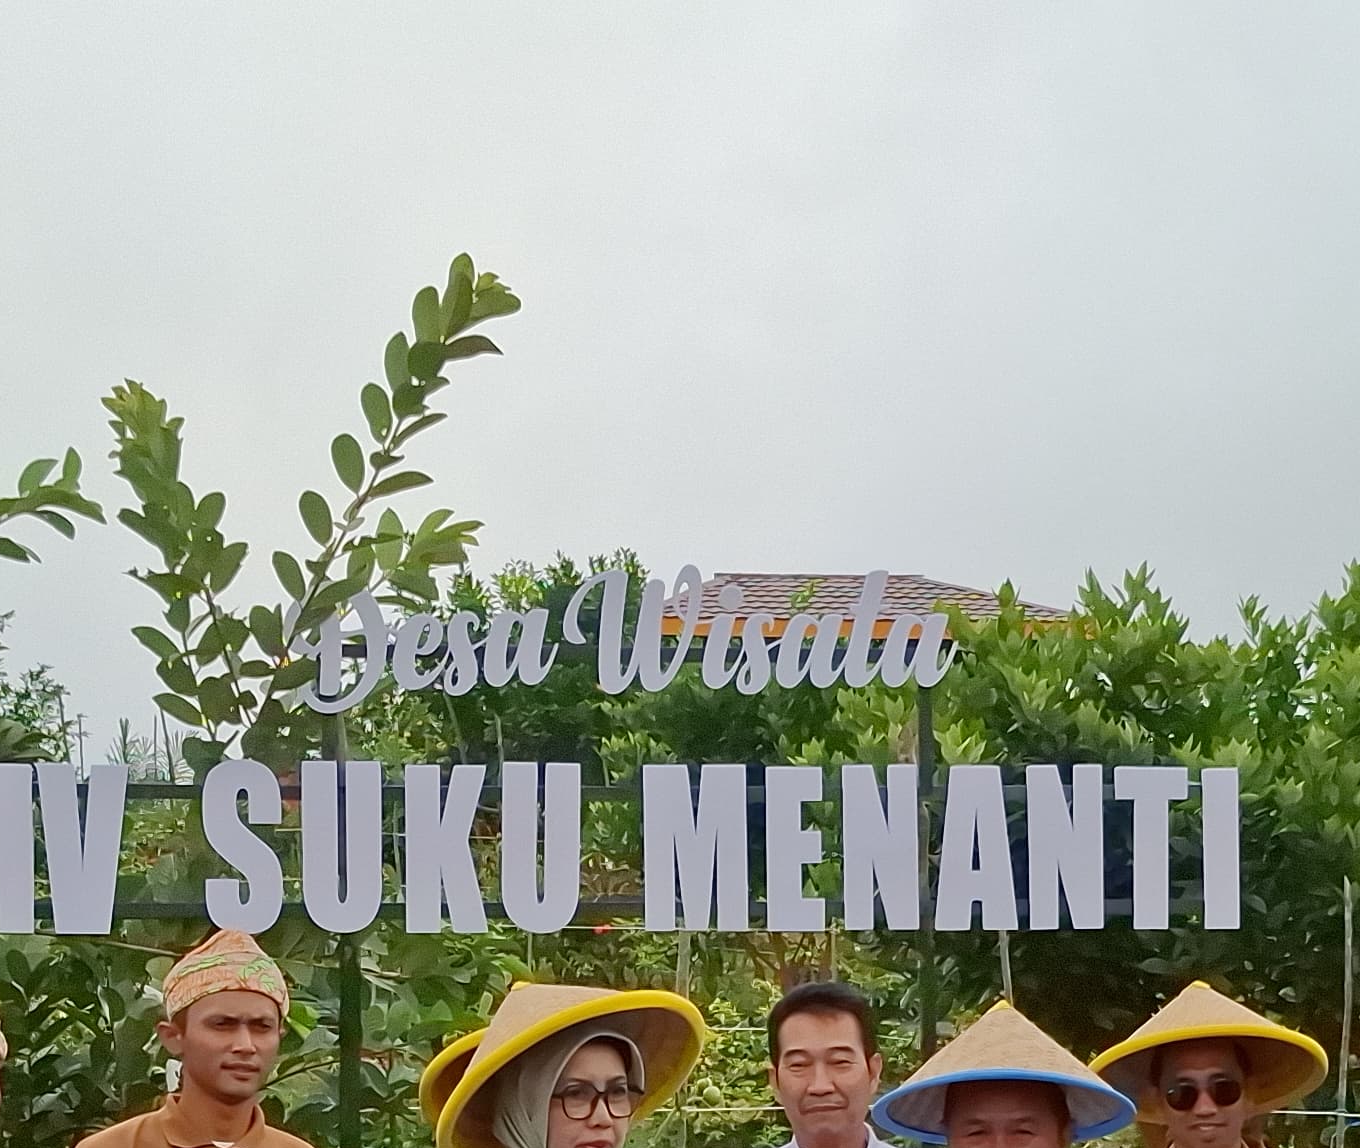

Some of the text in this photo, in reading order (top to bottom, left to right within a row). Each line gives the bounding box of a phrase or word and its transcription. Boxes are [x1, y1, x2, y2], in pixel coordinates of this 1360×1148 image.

[285, 566, 962, 714] Desa Wisata
[201, 759, 582, 935] SUKU
[641, 763, 1240, 932] MENANTI
